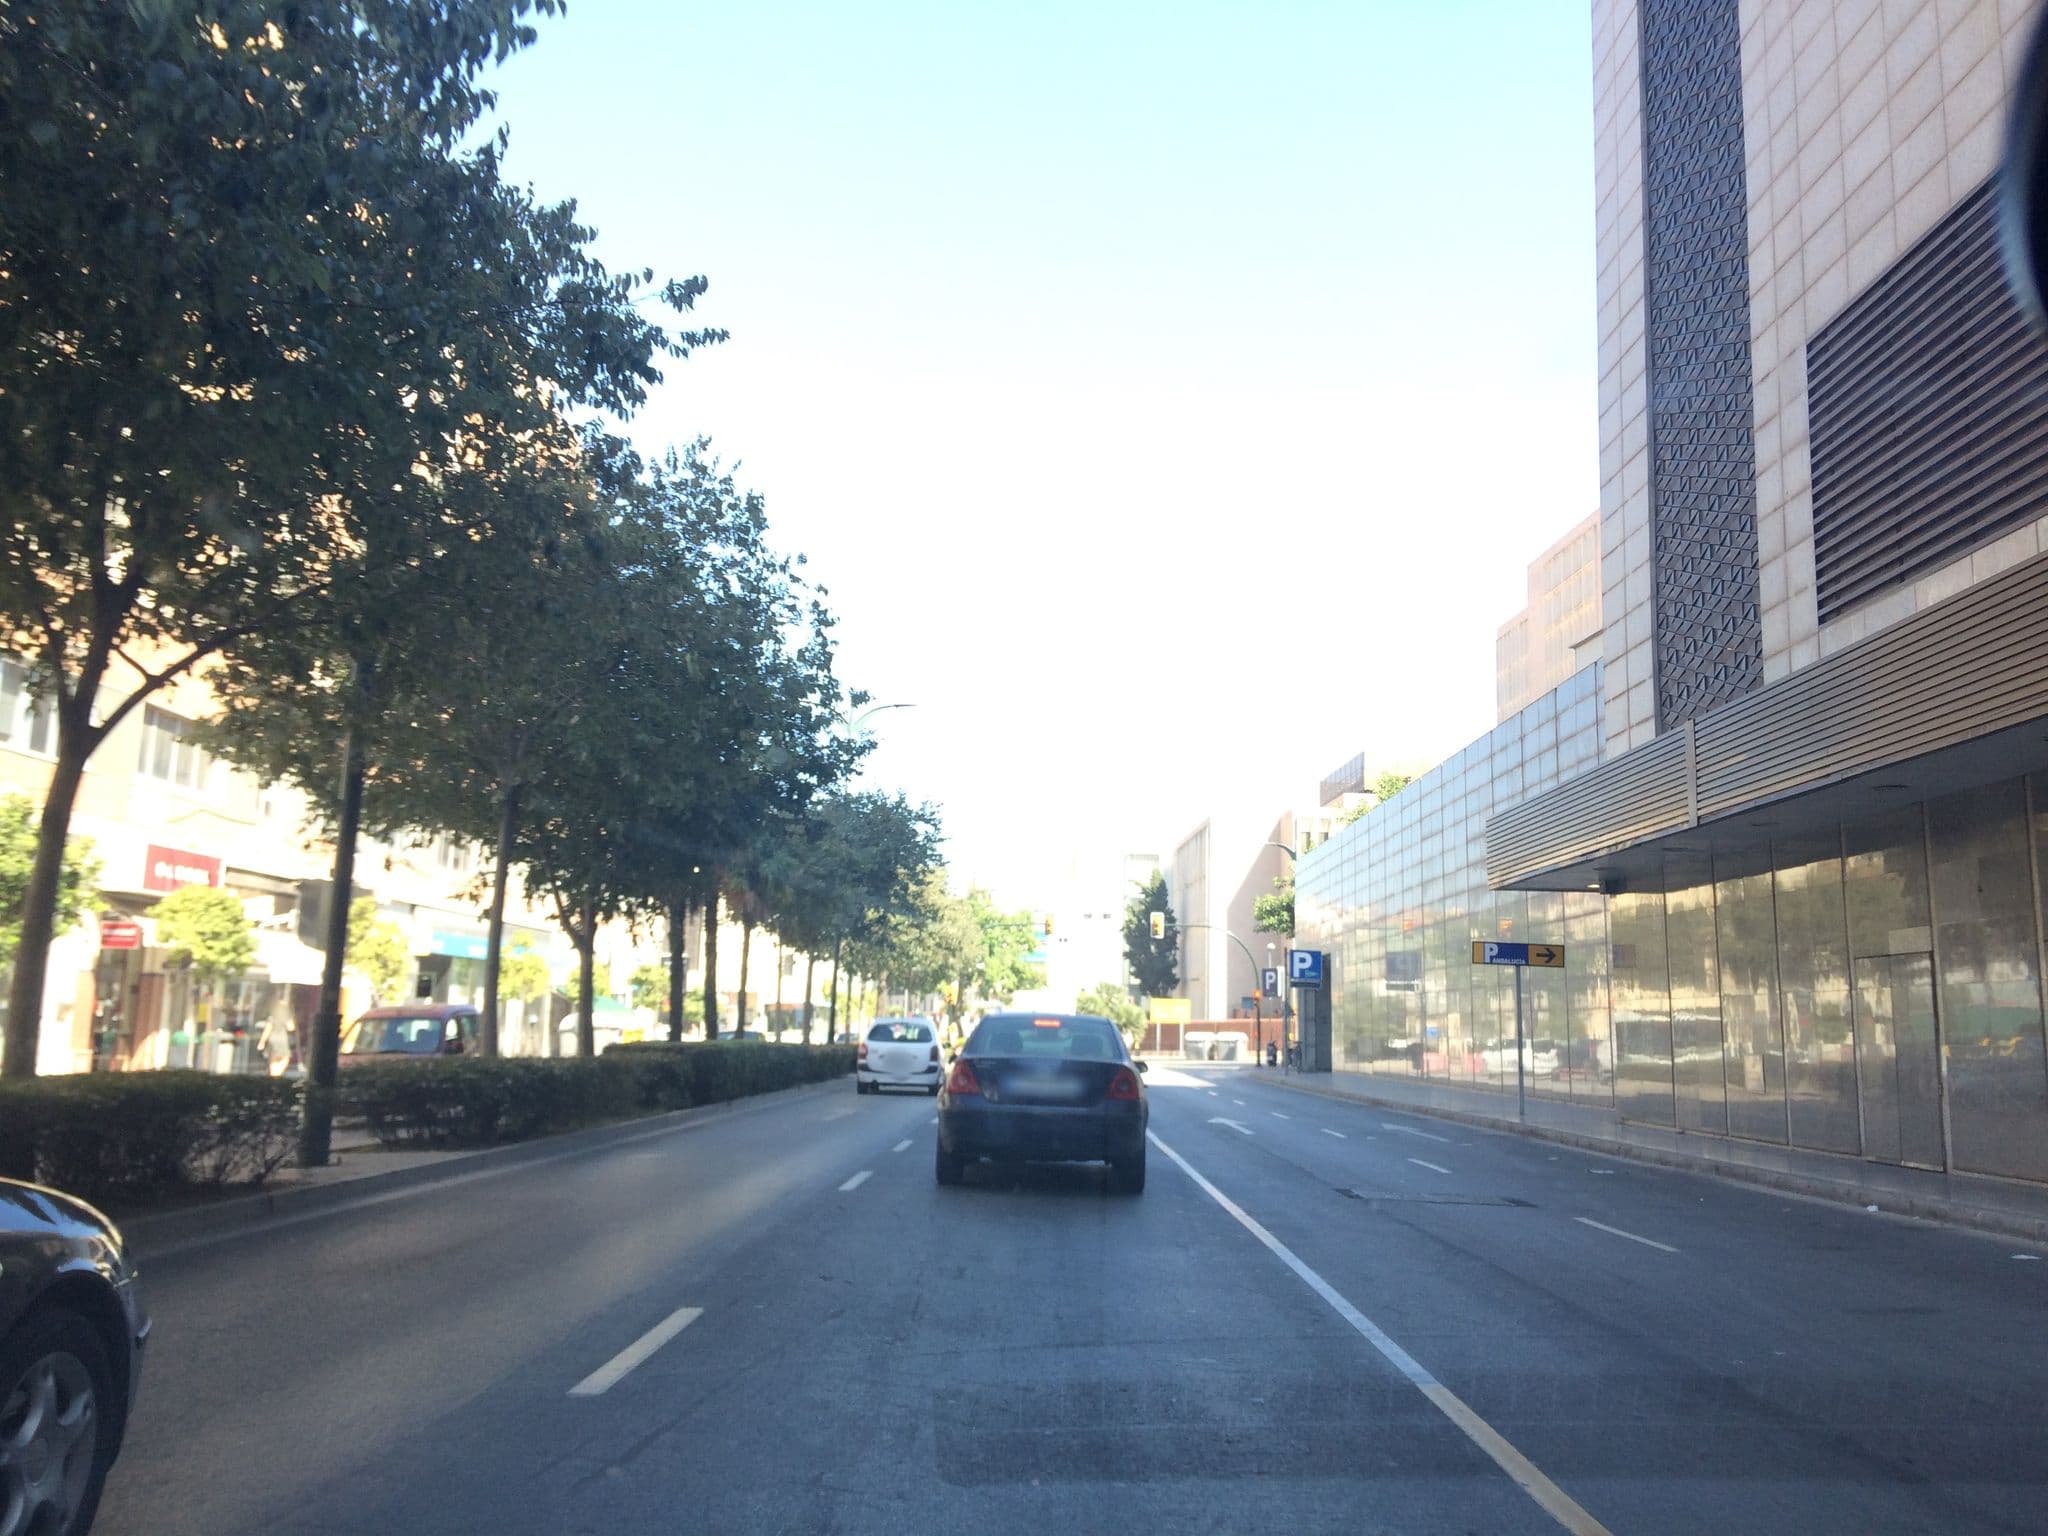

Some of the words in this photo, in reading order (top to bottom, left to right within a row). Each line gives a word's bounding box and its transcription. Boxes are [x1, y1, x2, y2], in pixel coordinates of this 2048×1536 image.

[1484, 943, 1498, 963] P
[1293, 952, 1312, 977] P
[1265, 971, 1276, 989] P
